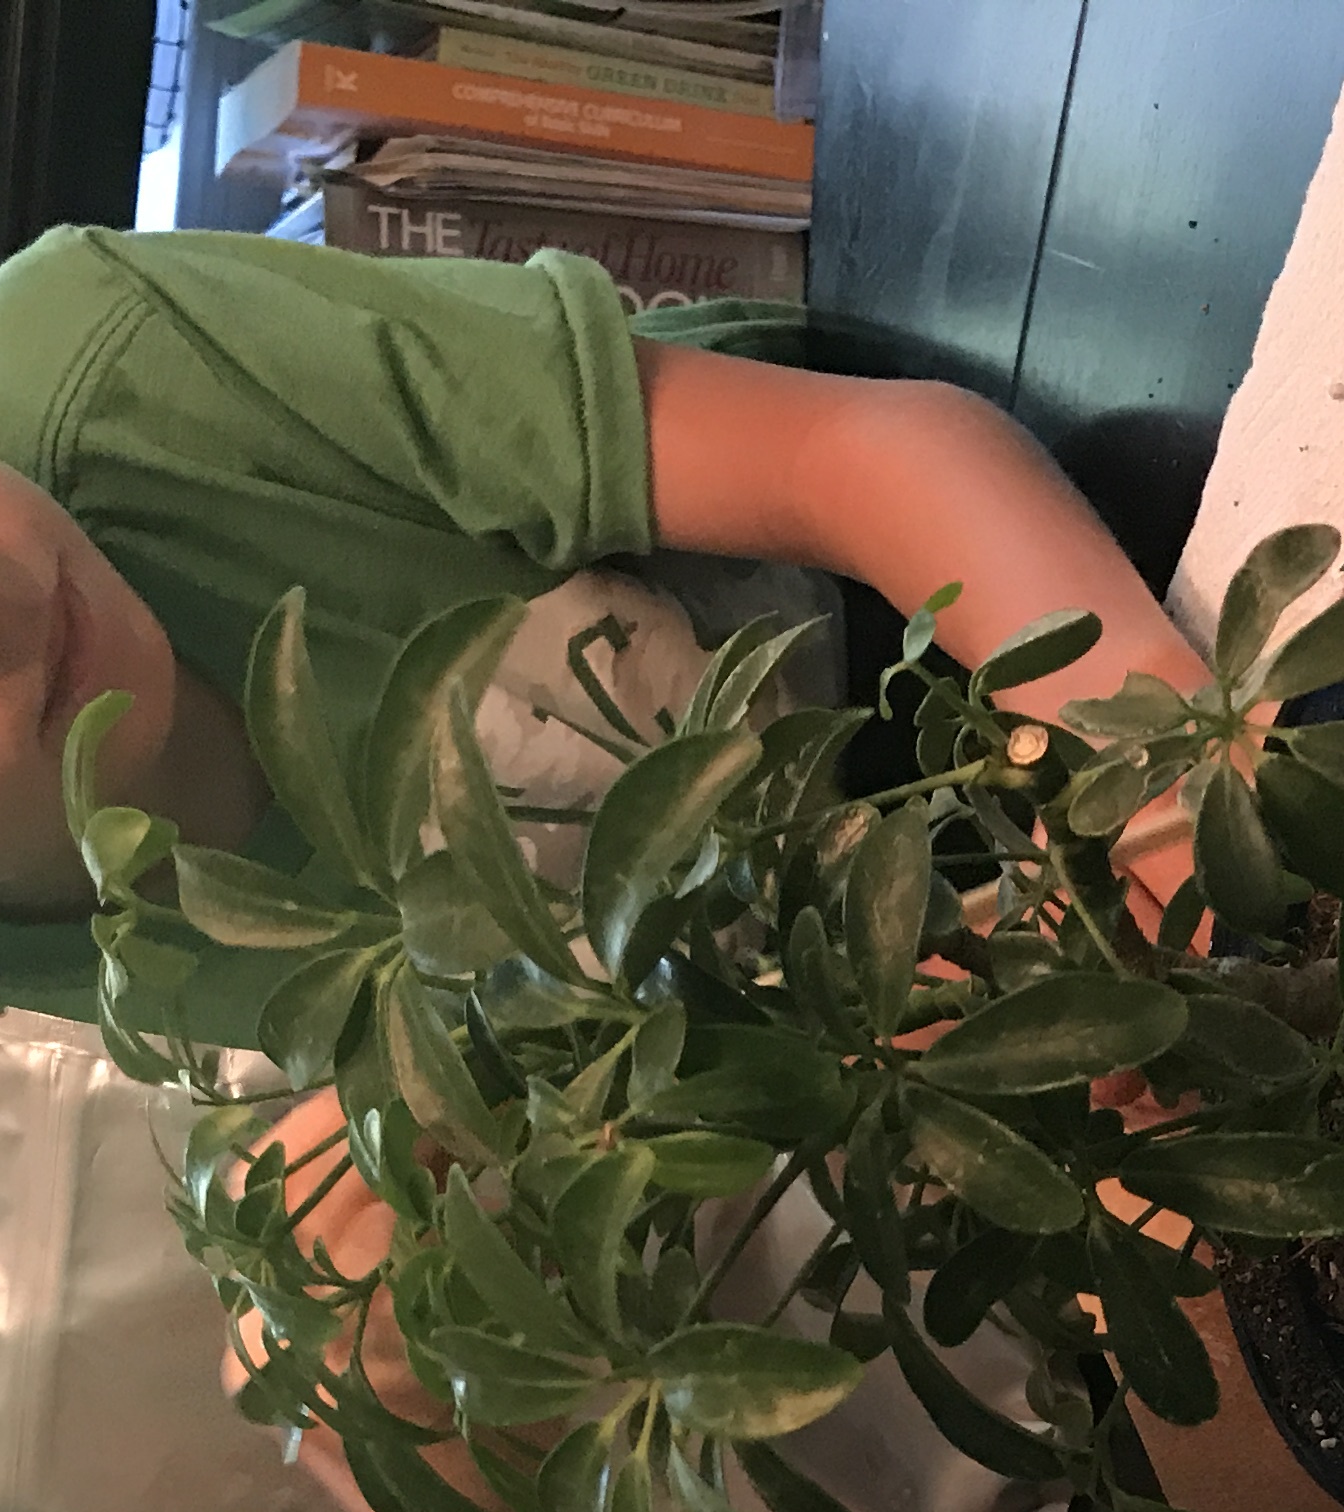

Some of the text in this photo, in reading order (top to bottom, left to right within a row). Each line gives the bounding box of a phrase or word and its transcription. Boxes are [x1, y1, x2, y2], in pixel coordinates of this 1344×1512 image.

[586, 65, 657, 90] GREEN
[367, 204, 464, 256] THE
[617, 224, 739, 291] Home
